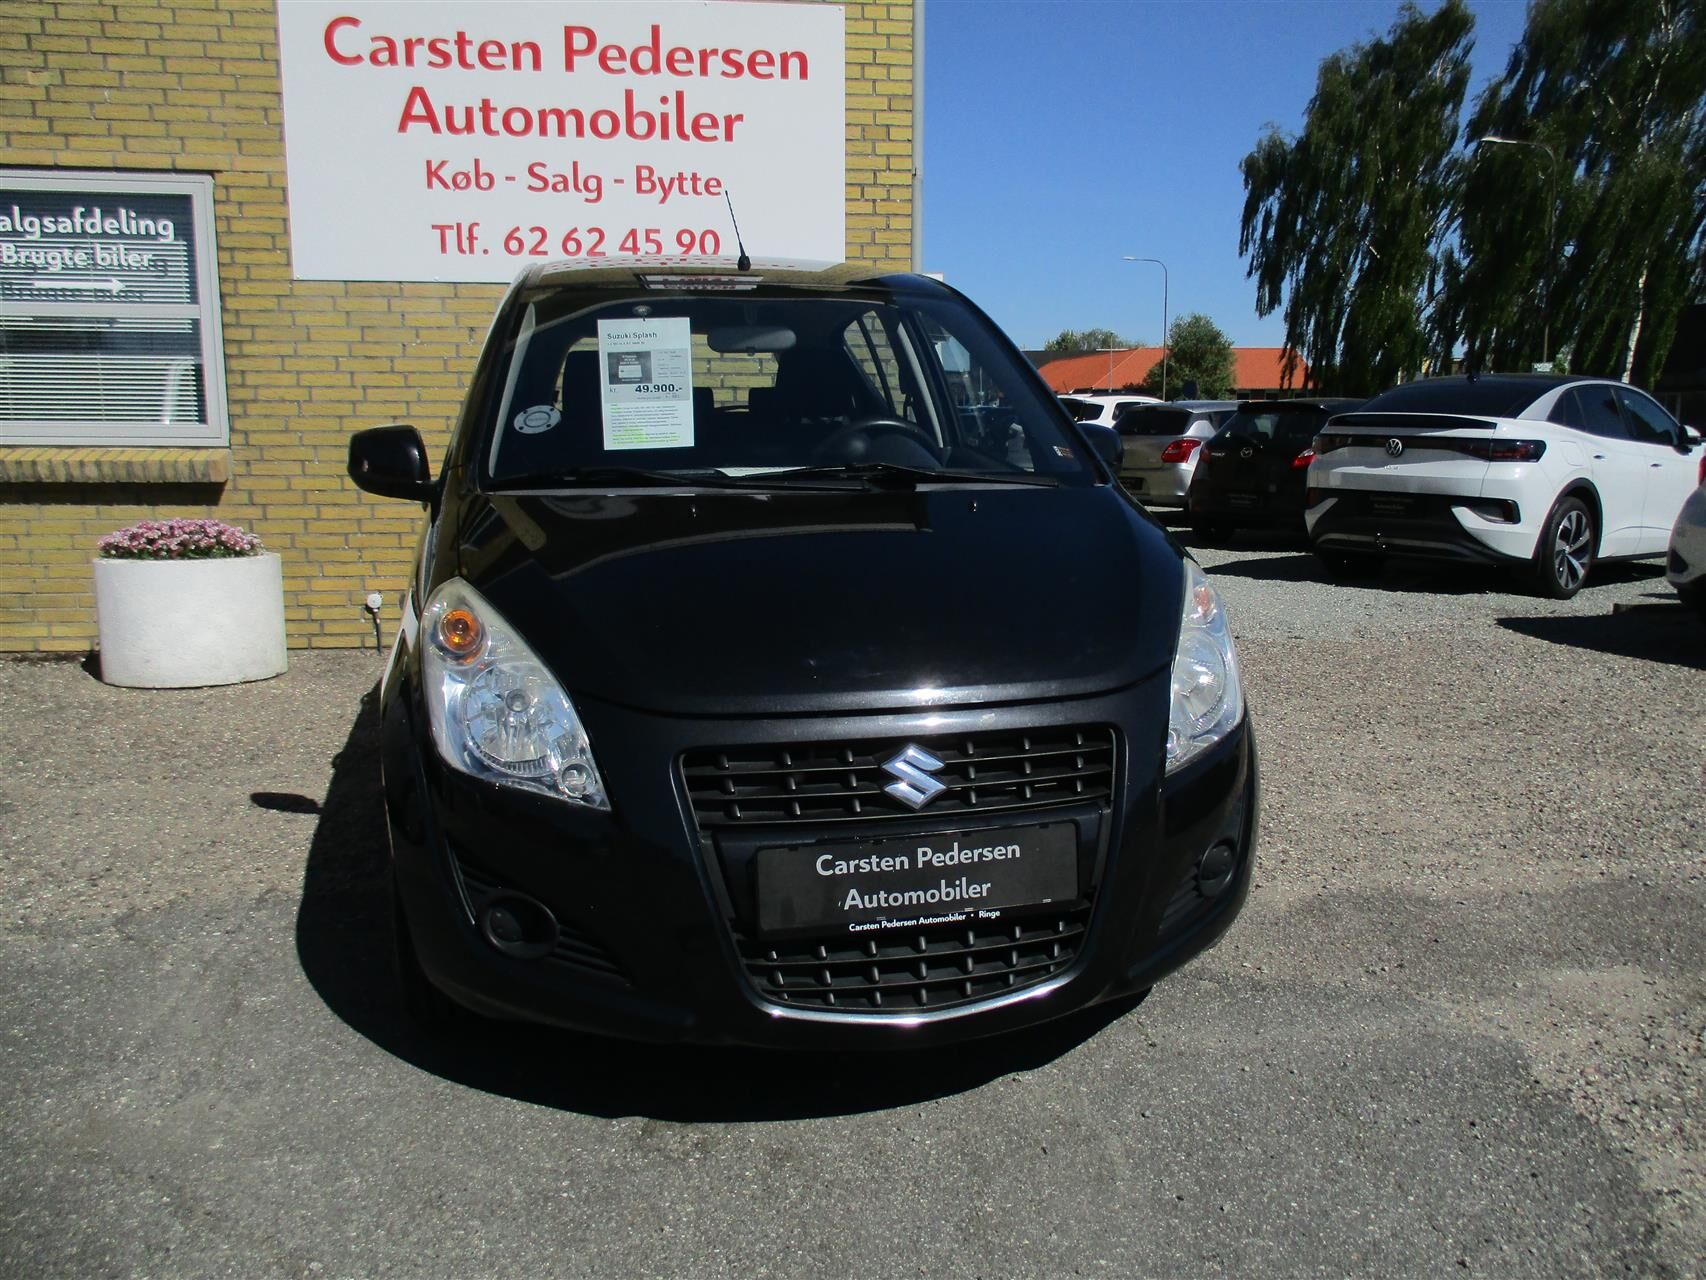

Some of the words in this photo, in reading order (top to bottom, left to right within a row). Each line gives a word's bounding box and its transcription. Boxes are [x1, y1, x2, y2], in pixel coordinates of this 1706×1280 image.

[323, 16, 542, 72] Carsten
[563, 24, 809, 80] Pedersen
[398, 86, 745, 142] Automobiler
[426, 159, 496, 191] Køb
[527, 161, 603, 203] Salg
[635, 165, 722, 204] Bytte
[431, 223, 489, 255] Tlf.
[503, 226, 548, 256] 62
[561, 227, 606, 256] 62
[619, 228, 663, 256] 45
[675, 229, 721, 256] 90
[1, 243, 88, 271] Brugte
[94, 243, 153, 267] biler
[633, 332, 657, 341] Splash
[635, 383, 683, 394] 49.900.-
[815, 853, 909, 876] Carsten
[916, 842, 1021, 869] Pedersen
[843, 877, 991, 911] Automobiler
[848, 922, 880, 932] Carsten
[881, 918, 917, 929] Pedersen
[918, 913, 967, 925] Automobiler
[978, 909, 1001, 919] Ringe
